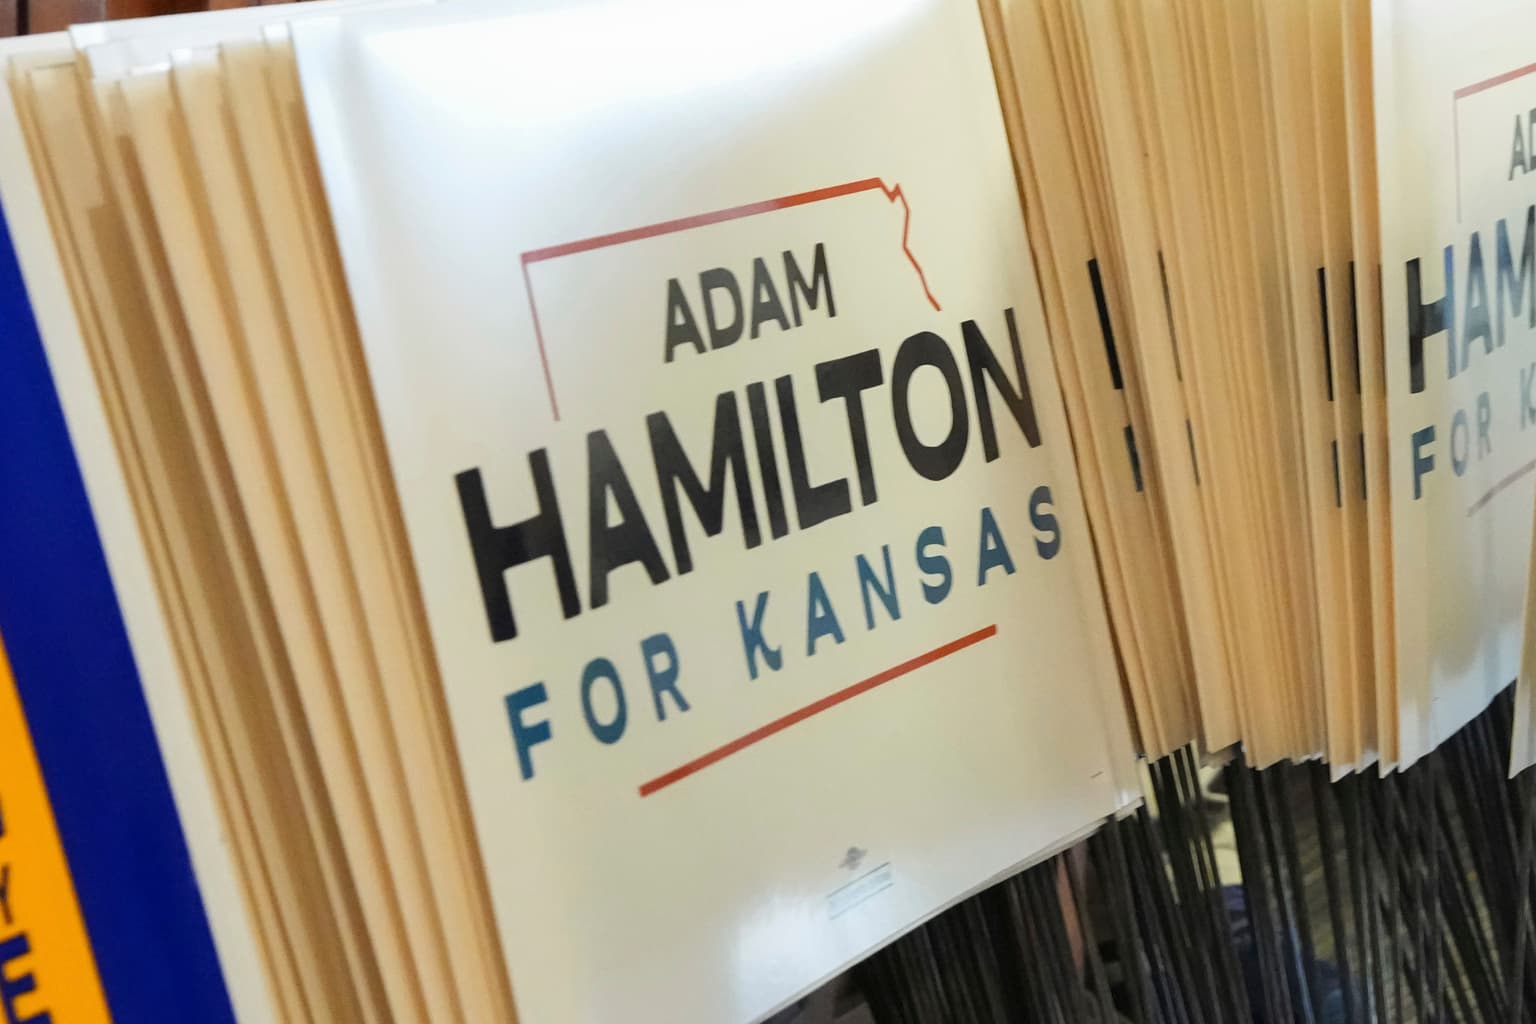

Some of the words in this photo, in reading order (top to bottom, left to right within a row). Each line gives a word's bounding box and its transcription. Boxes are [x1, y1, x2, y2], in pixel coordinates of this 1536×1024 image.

[663, 242, 837, 364] ADAM
[454, 307, 1042, 643] HAMILTON
[1411, 391, 1493, 500] FOR
[504, 632, 691, 781] FOR
[736, 486, 1062, 681] KANSAS
